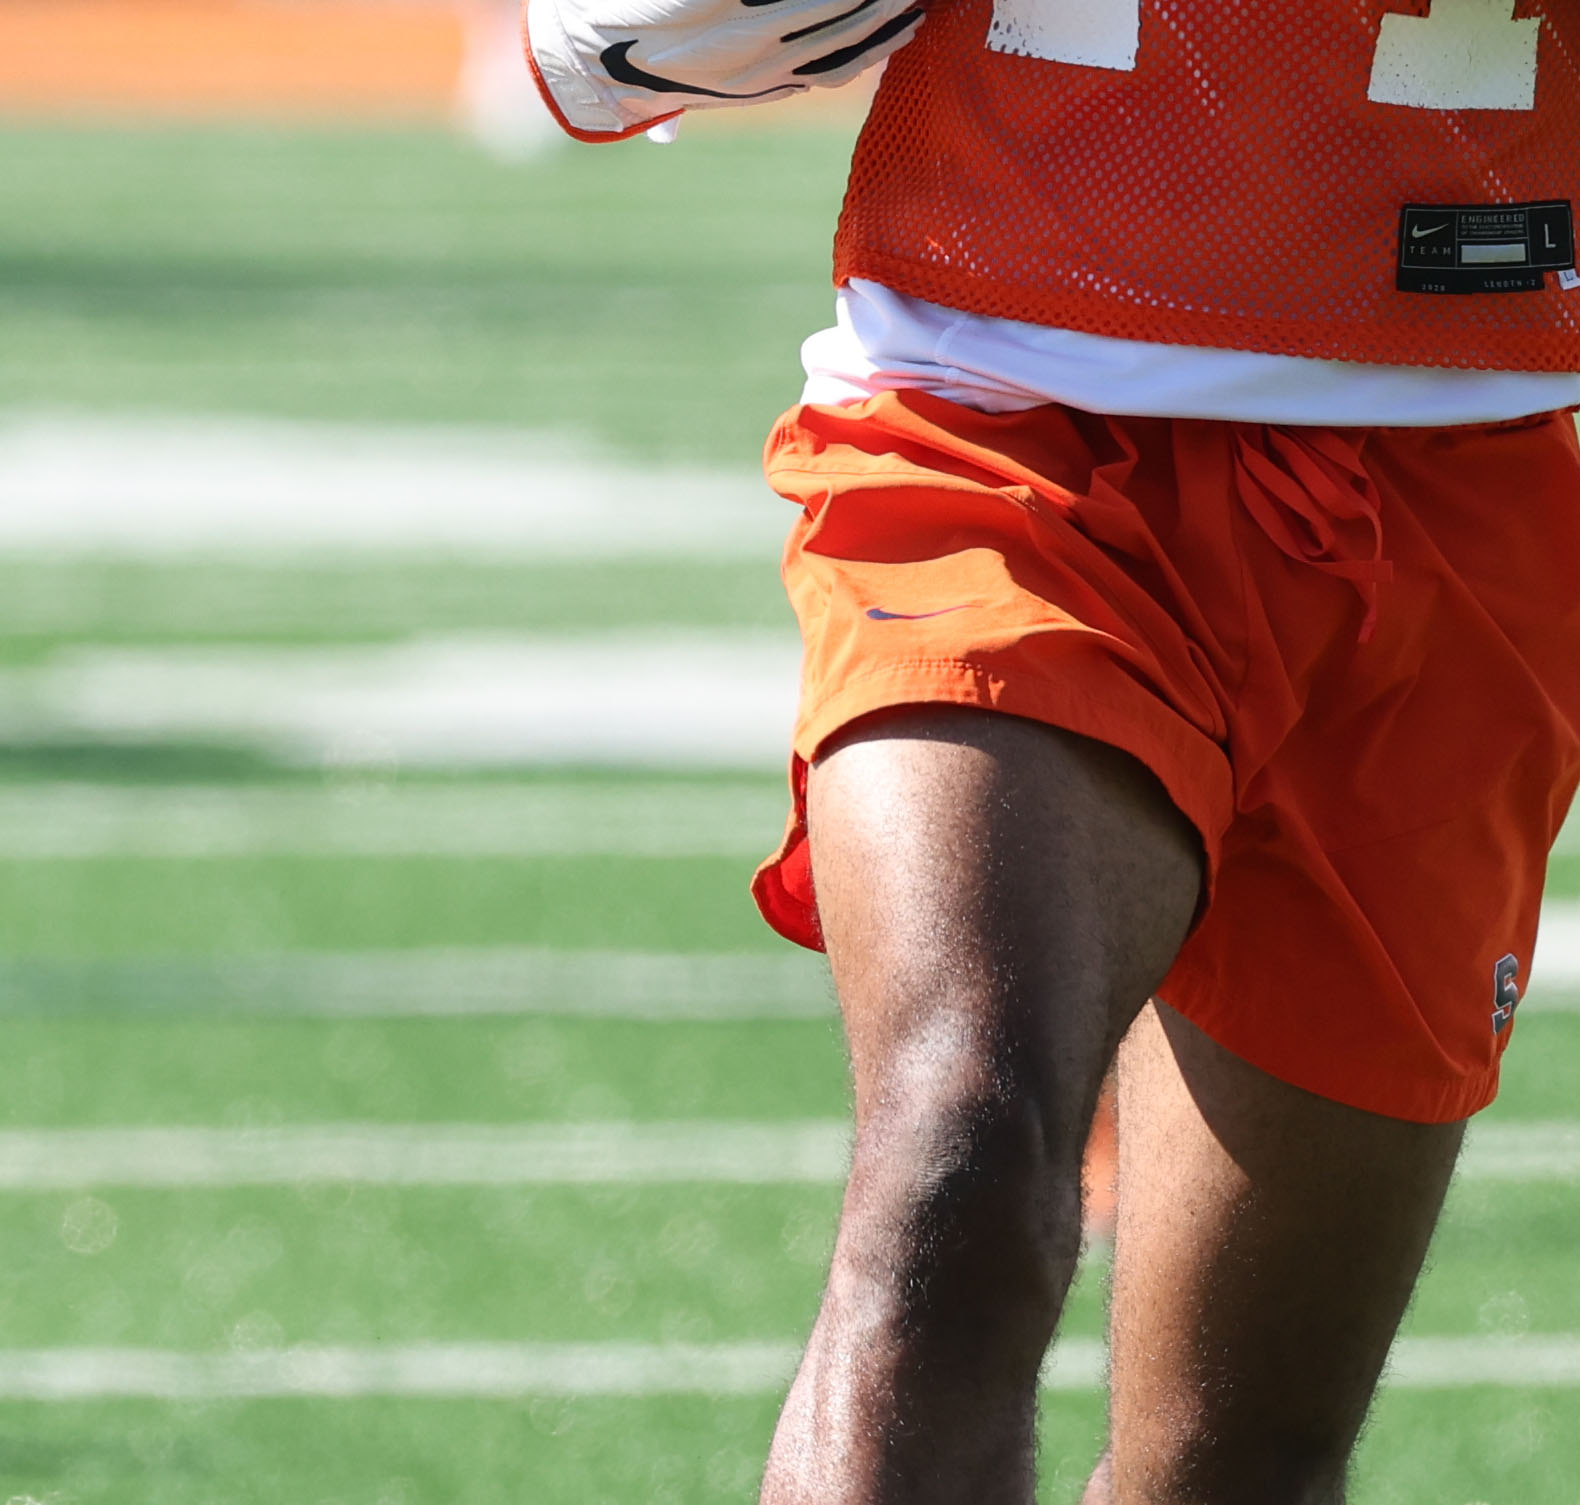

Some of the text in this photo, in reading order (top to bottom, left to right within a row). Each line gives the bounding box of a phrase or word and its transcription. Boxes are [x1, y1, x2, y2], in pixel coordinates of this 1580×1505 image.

[1461, 214, 1525, 224] ENGINEERED
[1544, 223, 1556, 248] L
[1409, 246, 1451, 255] TEAM
[1564, 271, 1574, 282] L
[1491, 953, 1519, 1036] S
